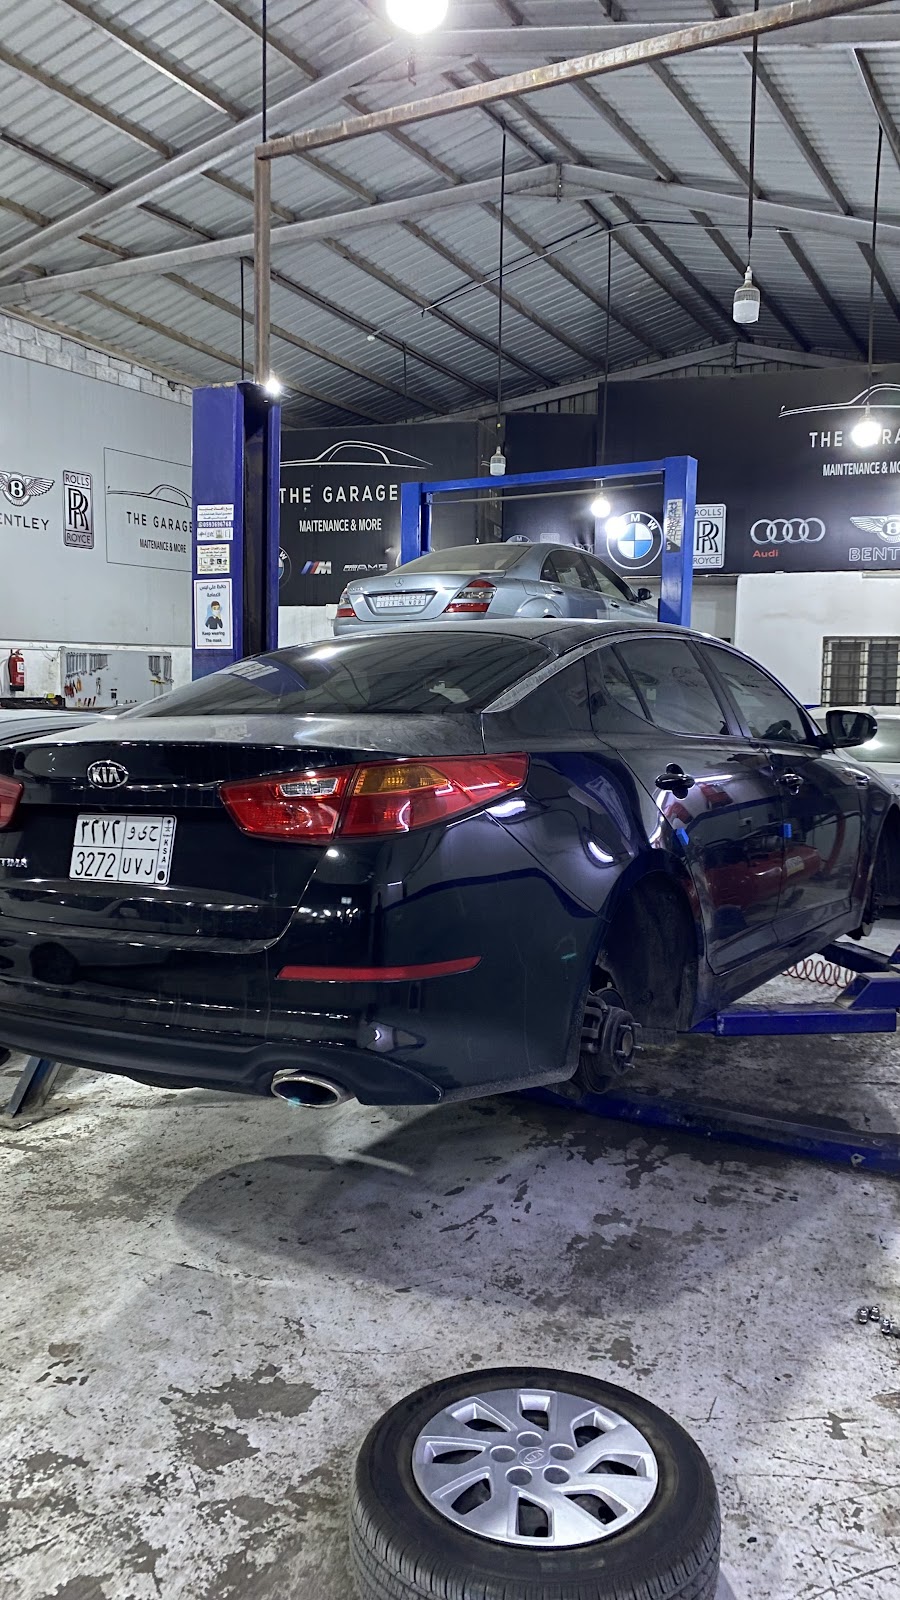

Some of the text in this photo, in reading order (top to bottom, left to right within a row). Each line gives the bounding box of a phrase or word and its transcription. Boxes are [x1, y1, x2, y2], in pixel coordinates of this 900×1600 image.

[809, 431, 843, 448] THE
[823, 462, 880, 476] MAINTENANCE
[881, 461, 888, 474] &
[65, 474, 89, 486] ROLLS
[279, 484, 398, 503] THE GARAGE
[0, 513, 49, 531] NTLEY
[126, 511, 147, 526] THE
[299, 518, 382, 532] MAITENANCE & MORE
[66, 533, 91, 544] ROYCE
[173, 543, 187, 554] MORE
[753, 549, 779, 558] Audi
[91, 766, 121, 784] KIA
[75, 851, 155, 878] 3272 UVJ
